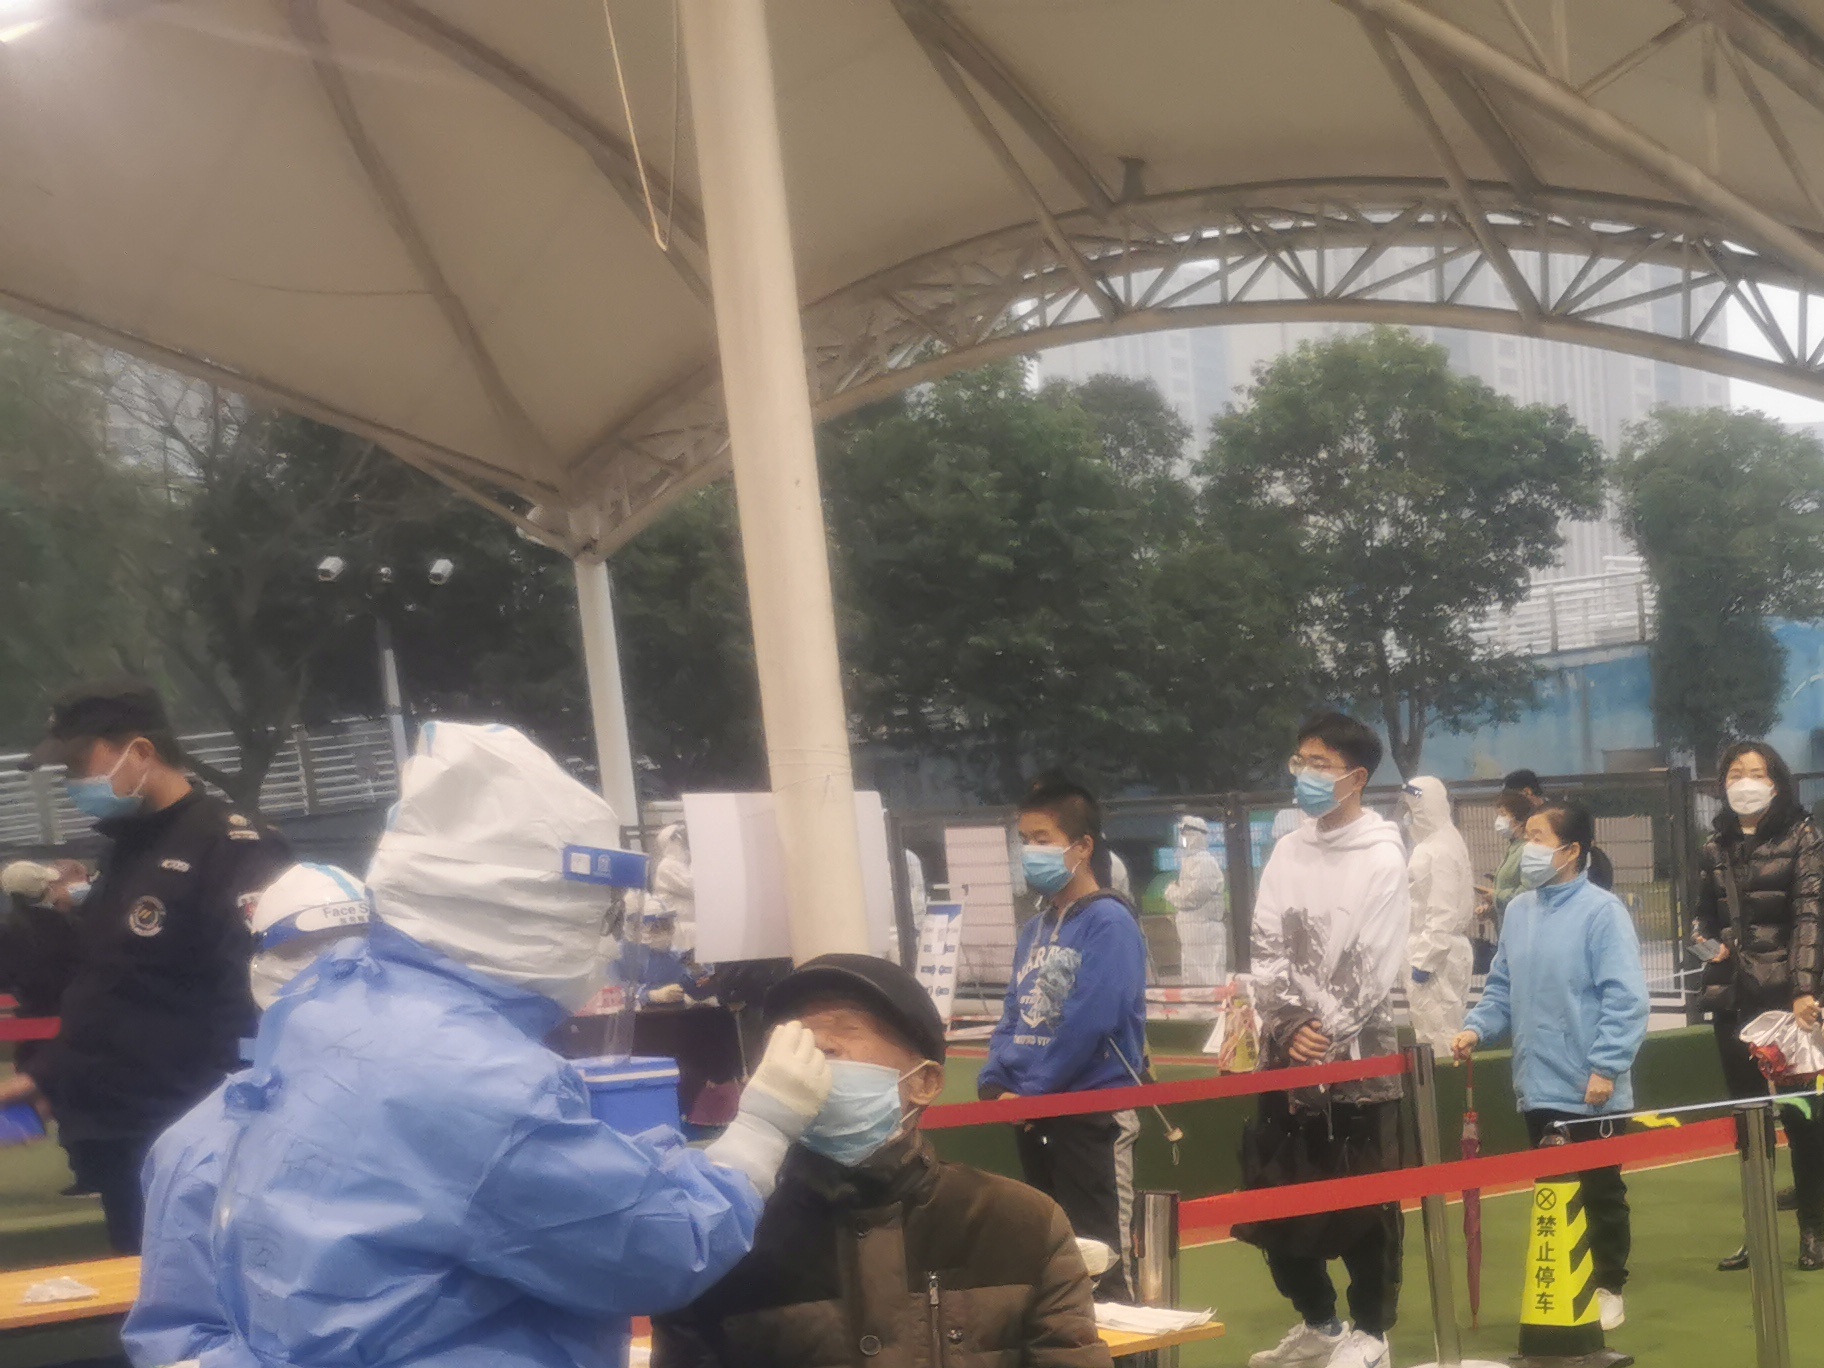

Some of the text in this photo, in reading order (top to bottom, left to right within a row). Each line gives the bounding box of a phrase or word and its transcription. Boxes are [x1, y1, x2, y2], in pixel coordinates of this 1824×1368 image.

[322, 906, 356, 919] Face
[1535, 1215, 1557, 1314] 禁止停车
